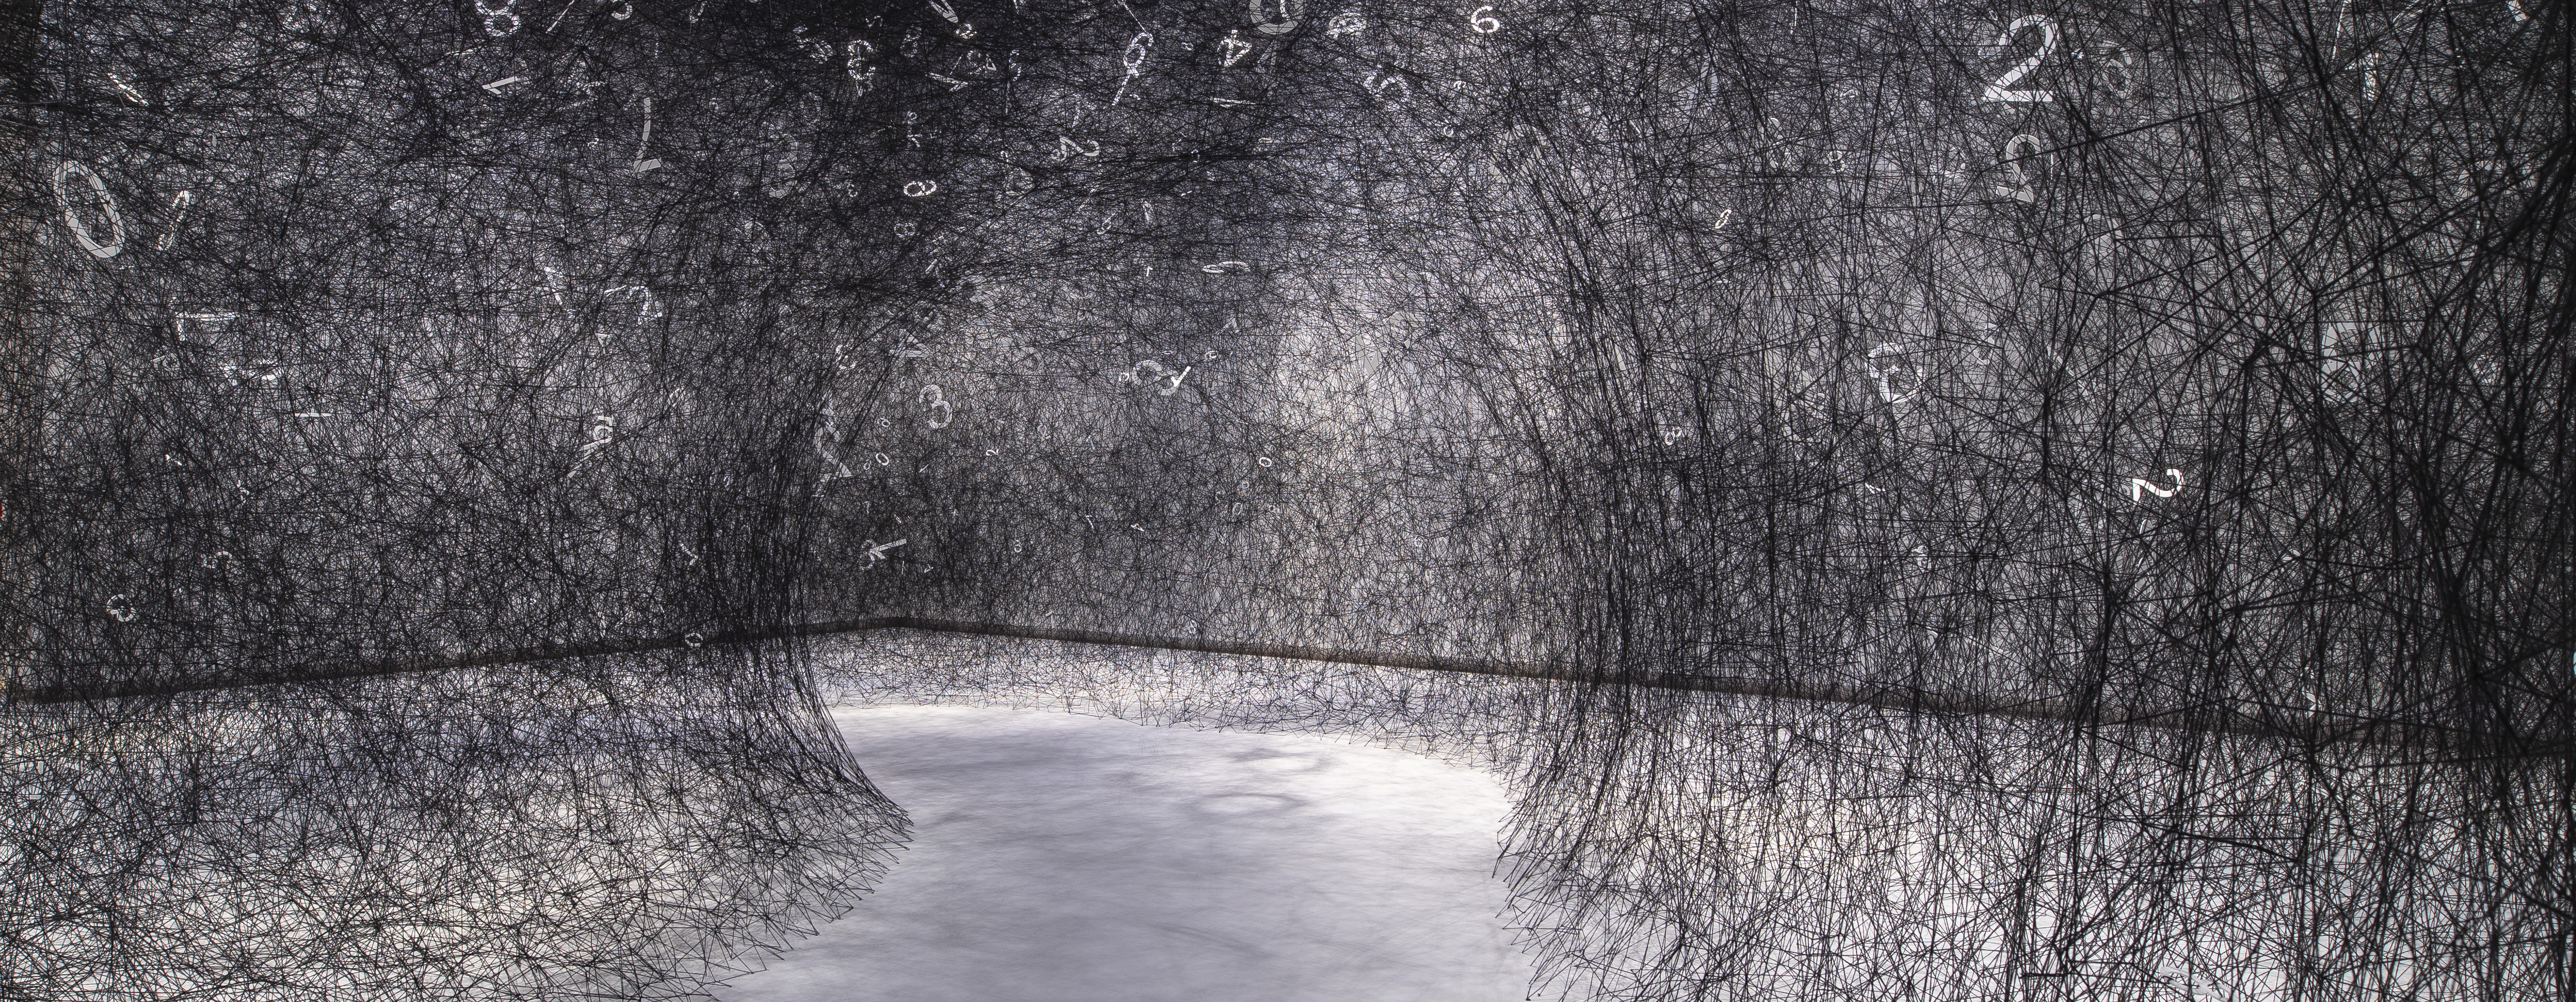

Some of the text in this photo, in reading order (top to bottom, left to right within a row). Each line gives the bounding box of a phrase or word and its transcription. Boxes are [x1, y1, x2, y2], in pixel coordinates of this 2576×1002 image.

[1470, 6, 1500, 33] 6
[1223, 29, 1252, 67] 4
[1982, 14, 2059, 102] 2
[54, 160, 125, 258] 0
[918, 384, 954, 429] 3
[876, 452, 890, 466] 0
[1258, 457, 1273, 468] 0
[2132, 468, 2184, 506] 2
